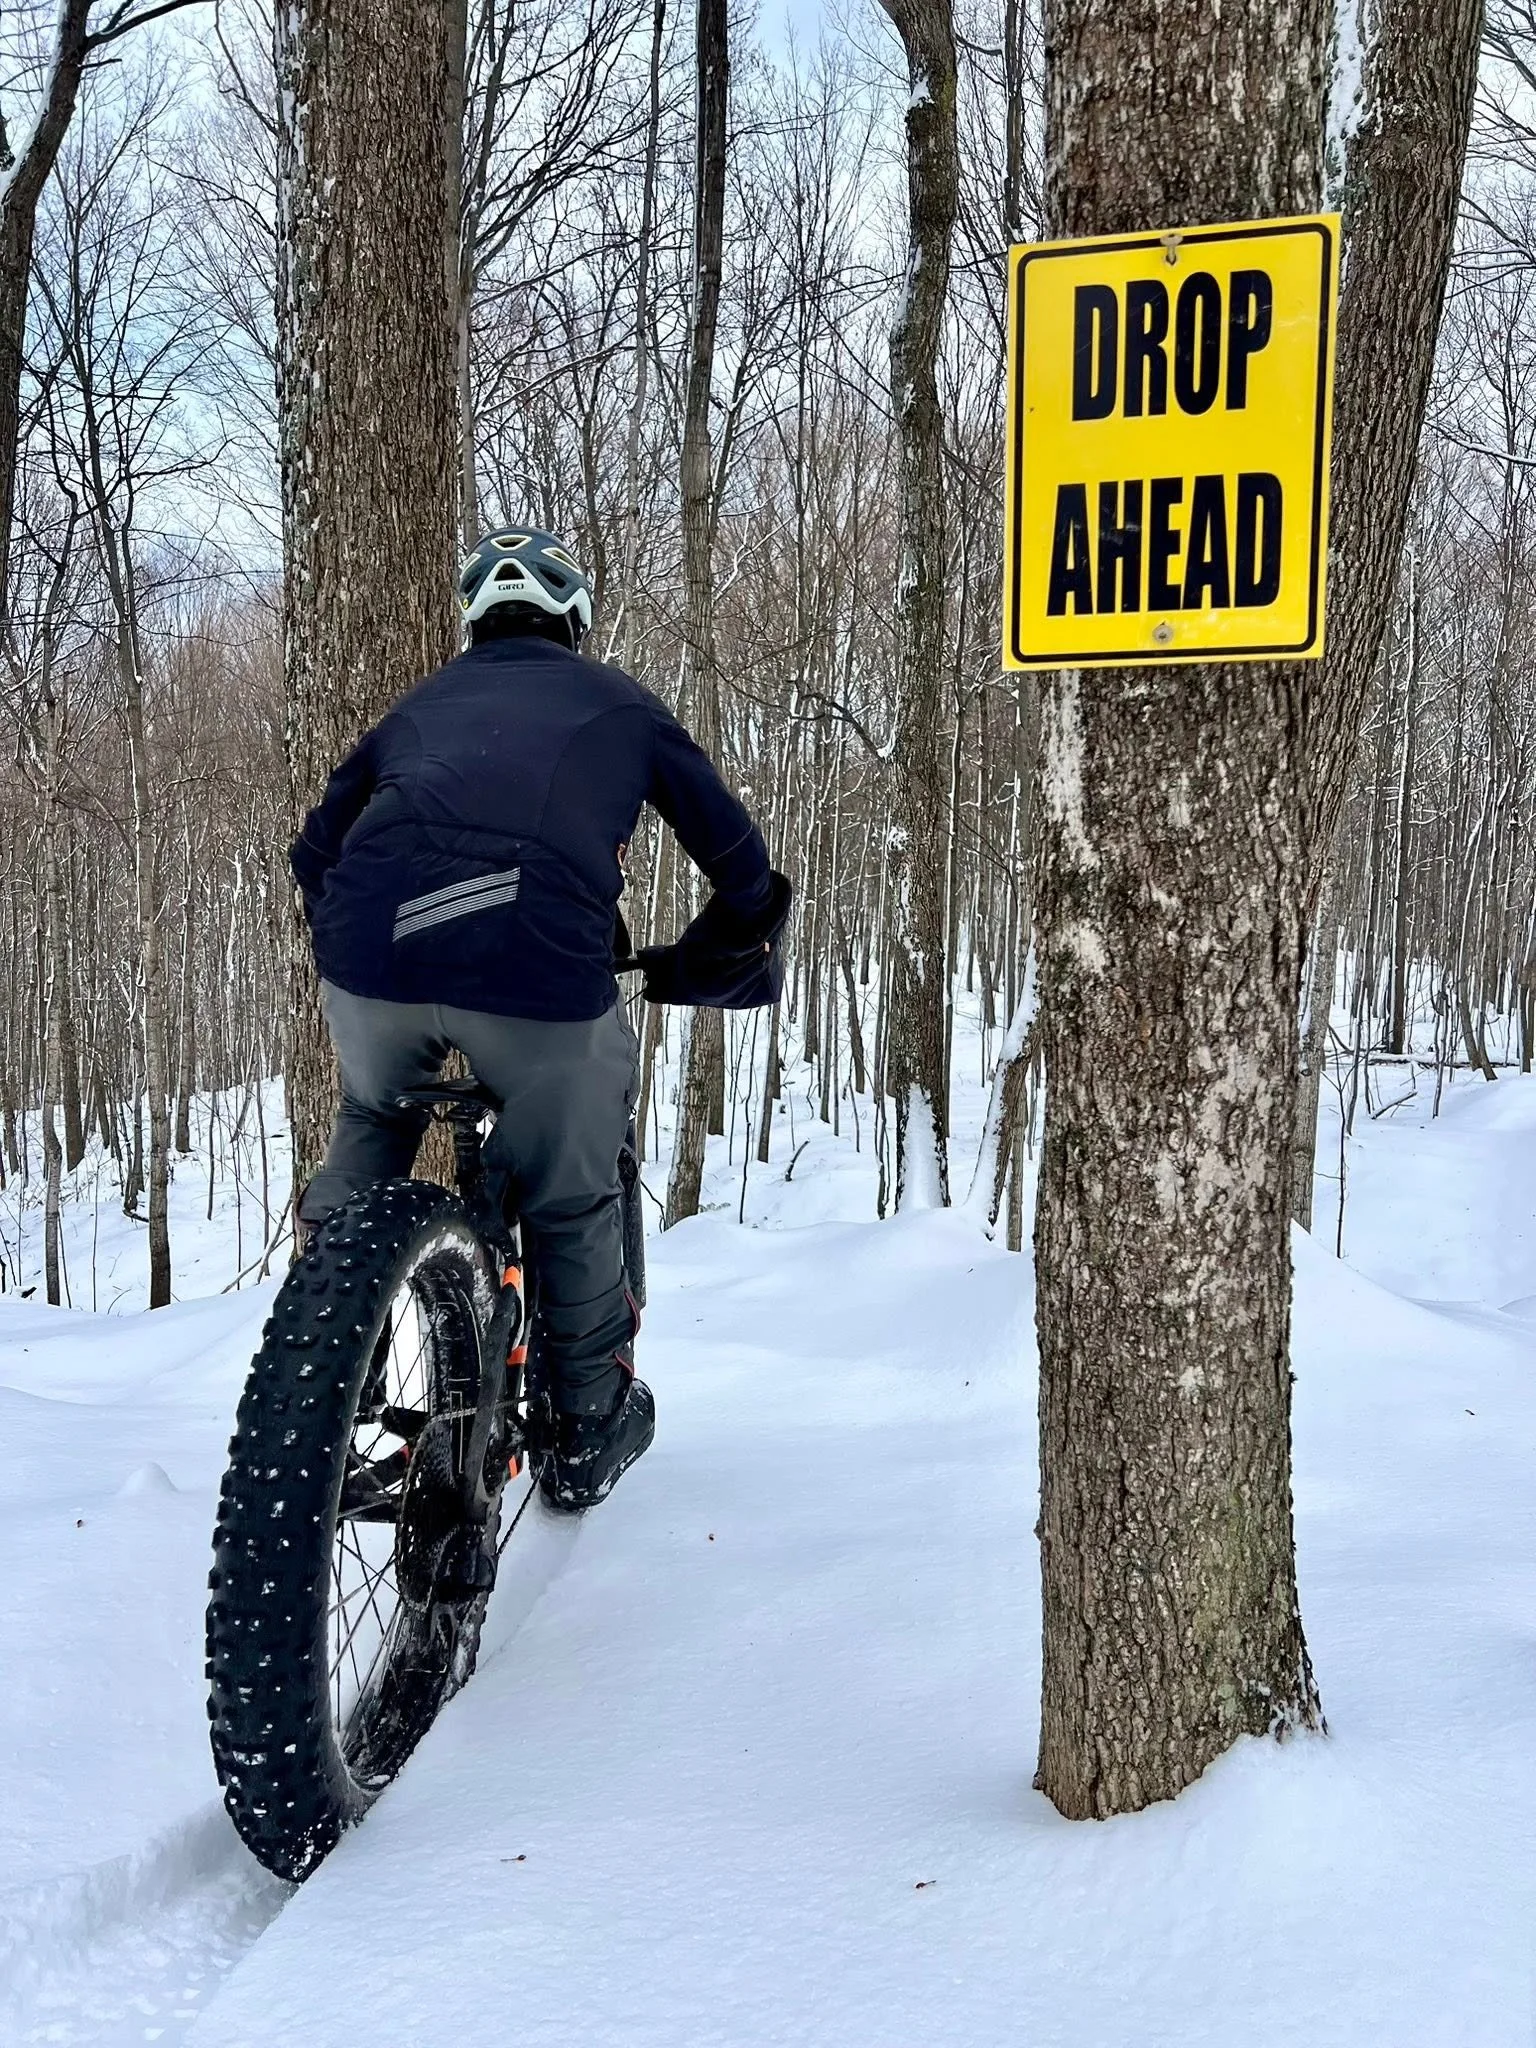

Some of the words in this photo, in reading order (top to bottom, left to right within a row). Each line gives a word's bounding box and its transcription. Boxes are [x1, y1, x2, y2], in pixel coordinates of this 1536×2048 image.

[1072, 269, 1273, 422] DROP
[498, 583, 525, 592] GIRO
[1046, 472, 1283, 617] AHEAD
